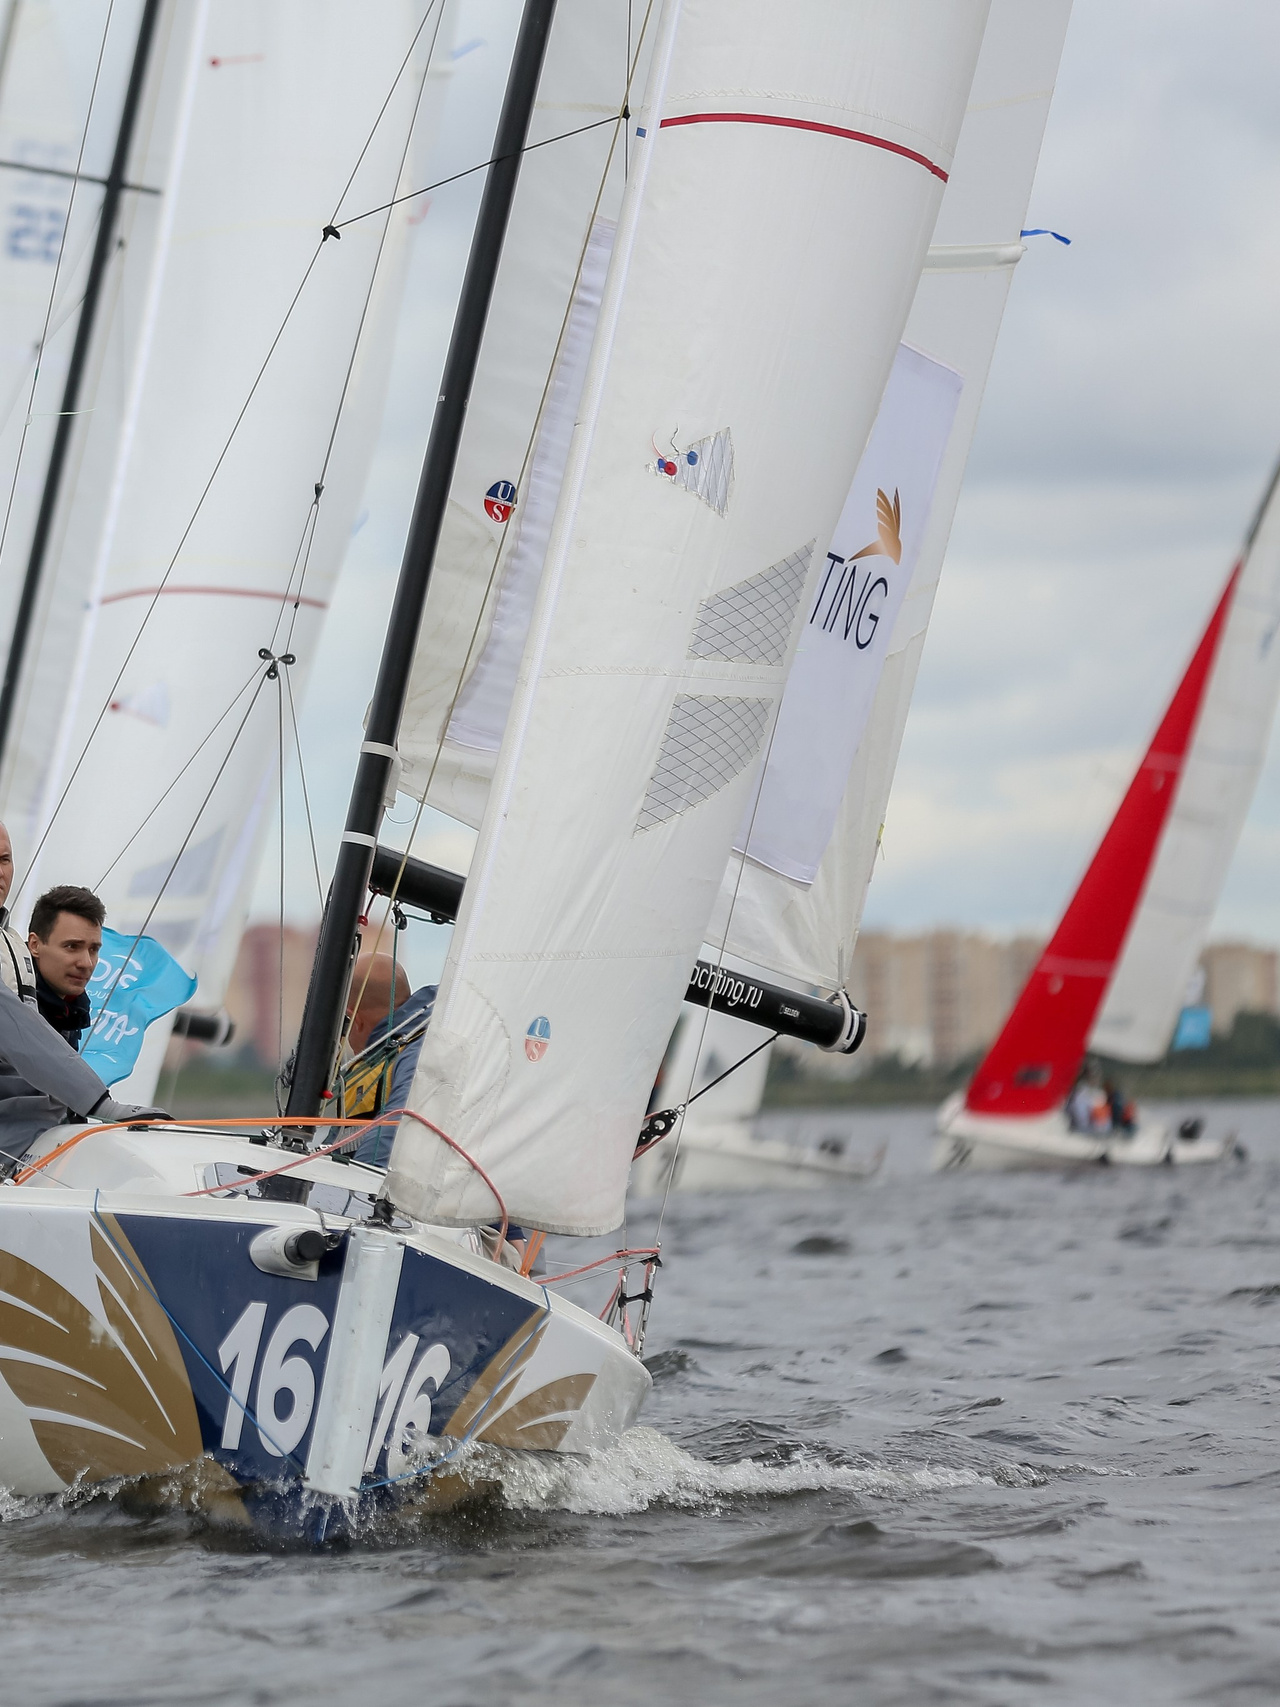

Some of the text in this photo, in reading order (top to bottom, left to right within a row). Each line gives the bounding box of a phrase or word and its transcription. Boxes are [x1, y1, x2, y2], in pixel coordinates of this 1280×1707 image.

[809, 551, 888, 650] TING
[218, 1300, 330, 1457] 16
[363, 1332, 451, 1486] 16
